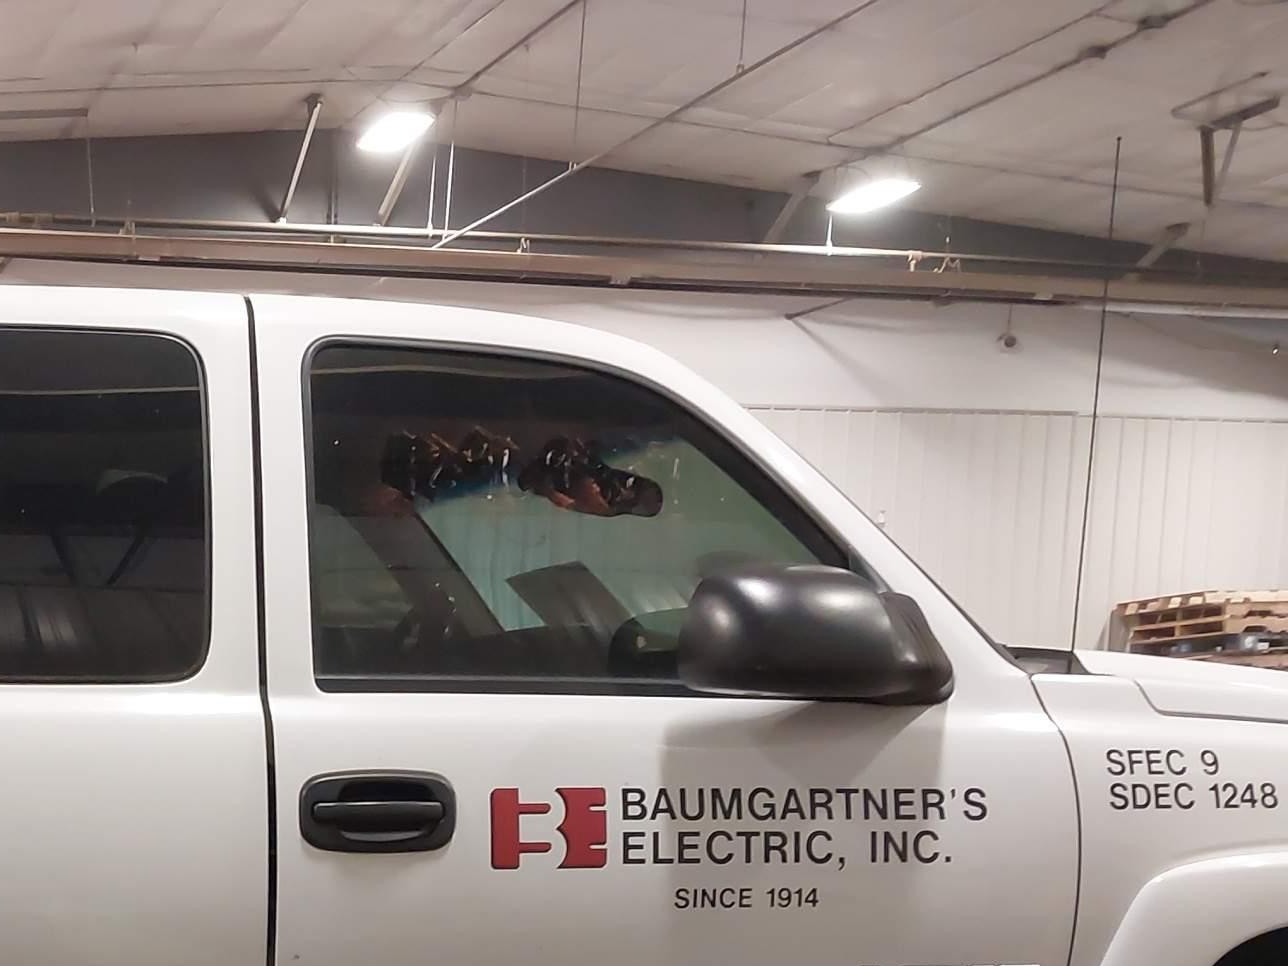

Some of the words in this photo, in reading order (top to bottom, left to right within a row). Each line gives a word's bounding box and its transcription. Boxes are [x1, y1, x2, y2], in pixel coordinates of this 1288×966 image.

[1106, 748, 1188, 776] SFEC
[1199, 749, 1220, 776] 9
[620, 786, 989, 822] BAUMGARTNER'S
[1109, 782, 1196, 811] SDEC
[1207, 782, 1279, 810] 1248
[621, 829, 847, 872] ELECTRIC,
[869, 829, 953, 865] INC.
[673, 887, 753, 910] SINCE
[765, 887, 820, 909] 1914
